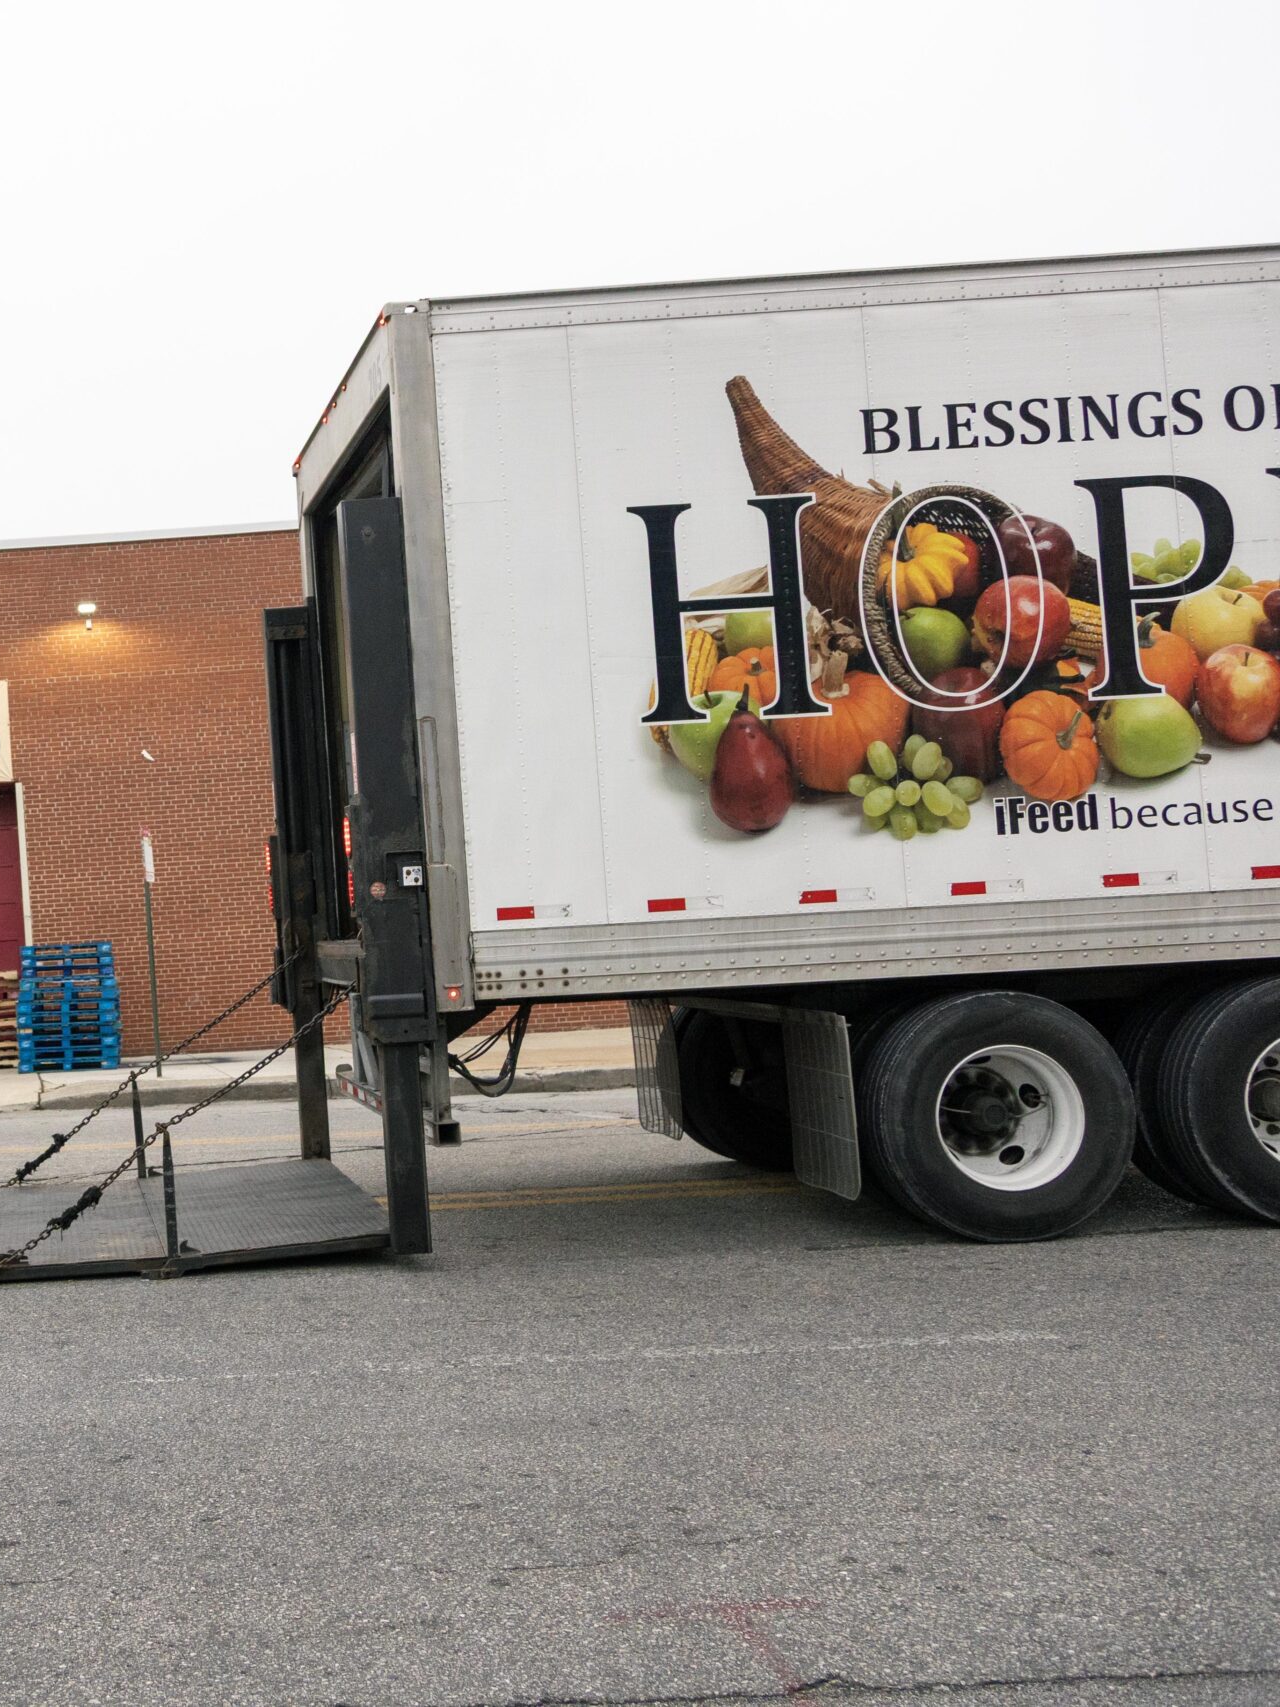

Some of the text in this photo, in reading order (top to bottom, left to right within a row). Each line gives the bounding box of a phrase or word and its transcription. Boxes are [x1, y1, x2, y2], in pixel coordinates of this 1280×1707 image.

[859, 388, 1203, 454] BLESSINGS
[626, 467, 1280, 725] HOP
[993, 793, 1274, 836] iFeed because
